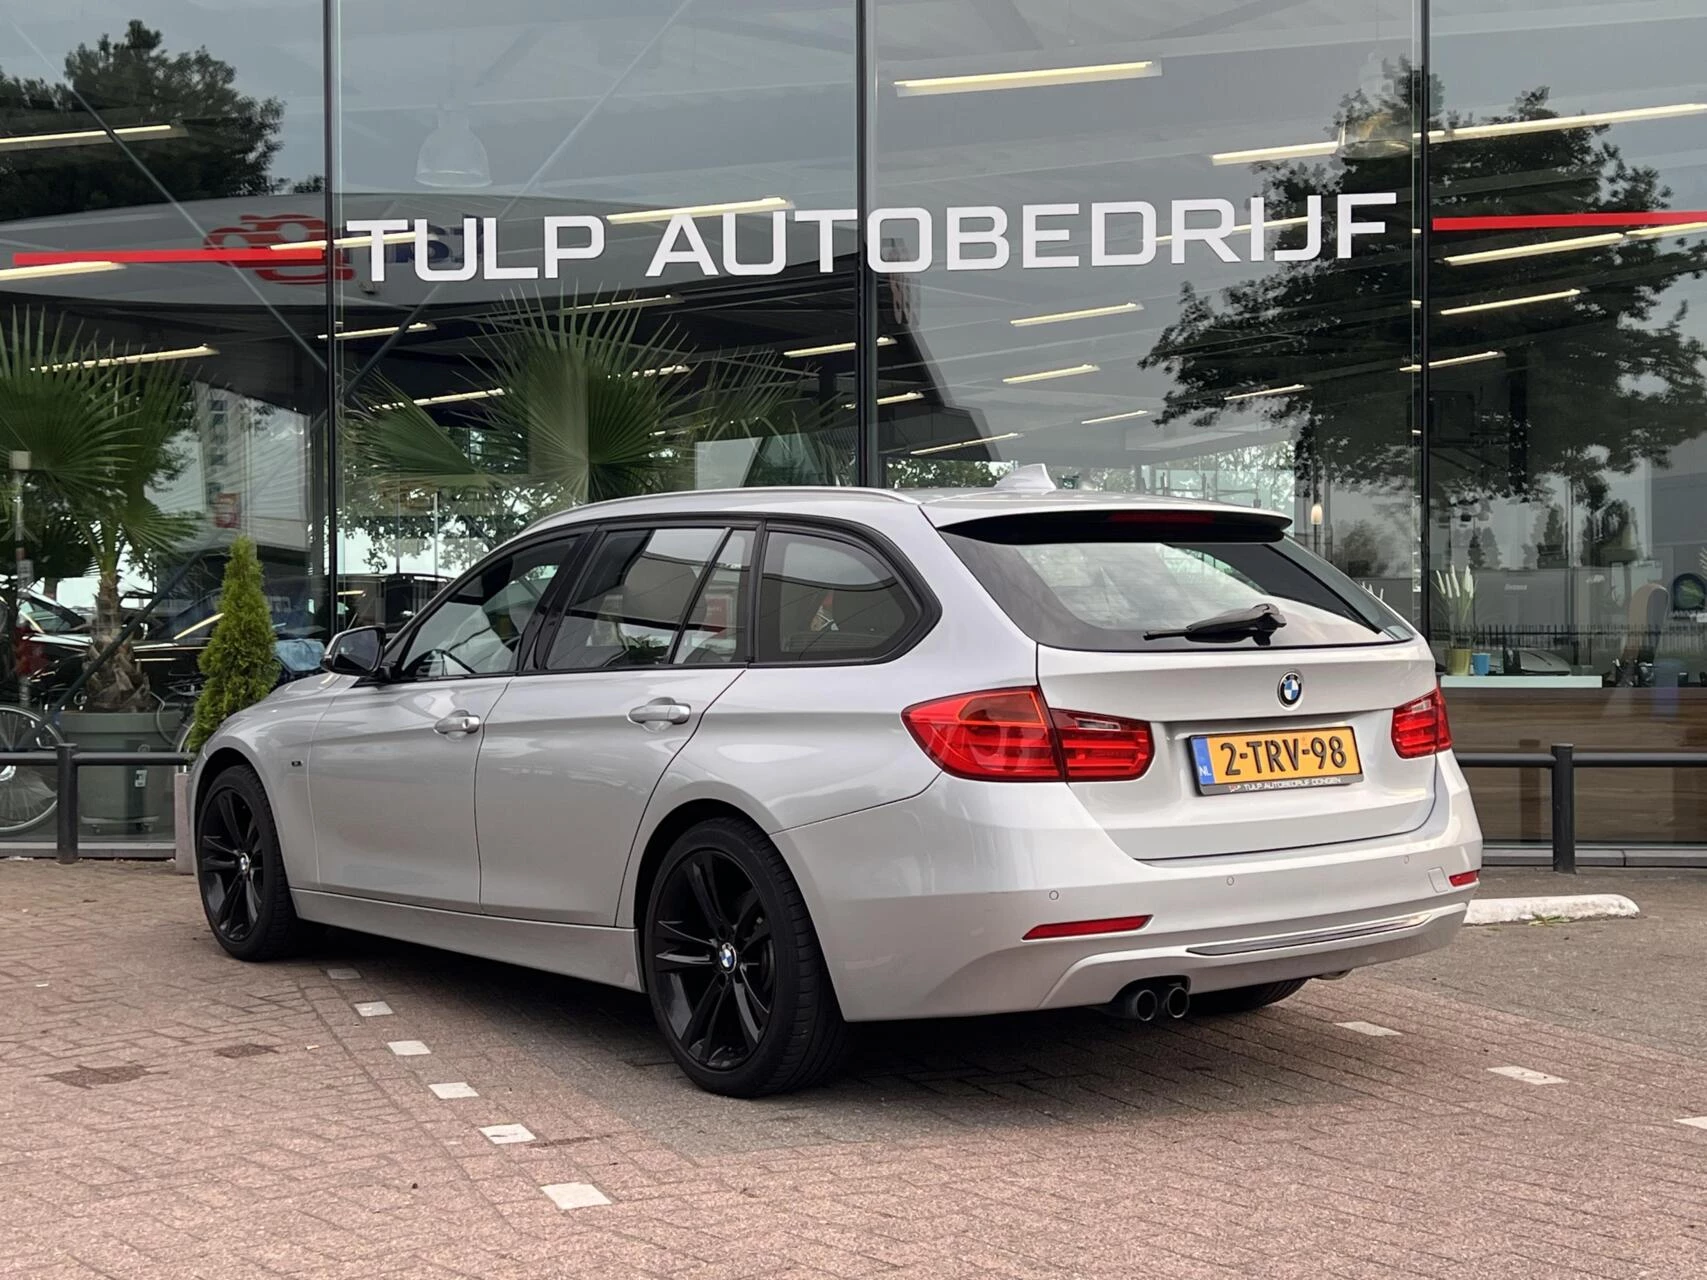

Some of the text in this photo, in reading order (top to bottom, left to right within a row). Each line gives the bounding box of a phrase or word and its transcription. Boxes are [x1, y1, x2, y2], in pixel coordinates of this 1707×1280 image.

[346, 192, 1397, 282] TULP AUTOBEDRIJF
[1199, 765, 1212, 777] NL
[1220, 735, 1347, 776] 2-TRV-98
